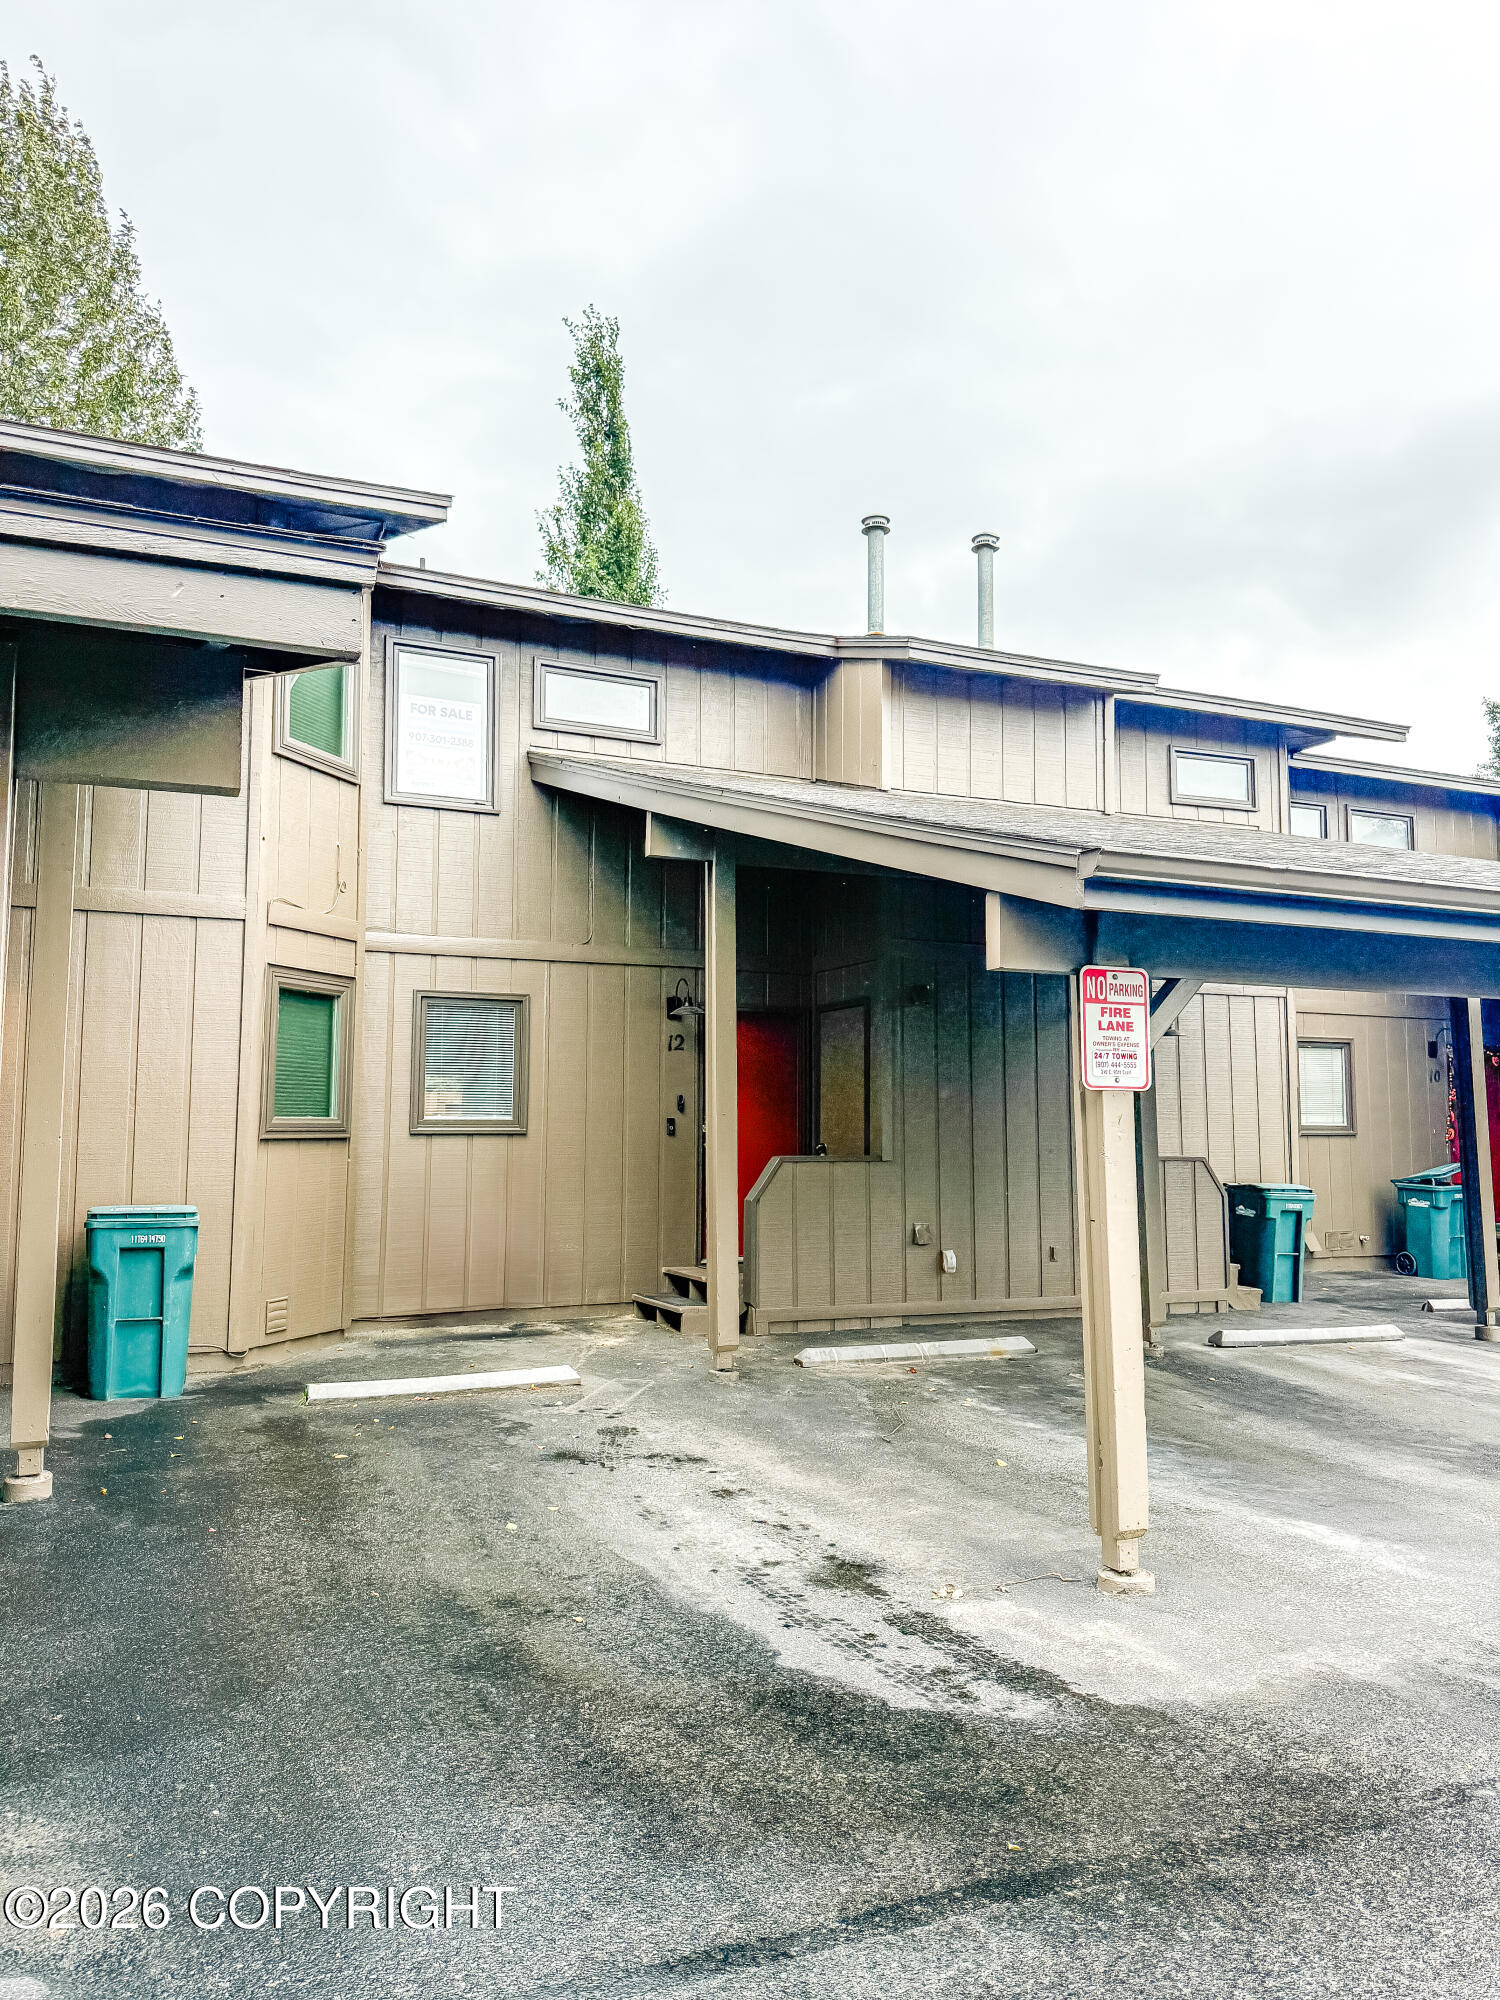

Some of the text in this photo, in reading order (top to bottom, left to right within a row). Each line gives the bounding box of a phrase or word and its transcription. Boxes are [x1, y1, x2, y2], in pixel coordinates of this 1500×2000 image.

[410, 703, 473, 721] FOR SALE
[1086, 976, 1144, 1000] NO PARKING
[1100, 1007, 1132, 1018] FIRE
[1098, 1020, 1135, 1032] LANE
[668, 1034, 685, 1051] 12
[1093, 1052, 1138, 1060] 24/7 TOWING
[1429, 1069, 1441, 1083] 10
